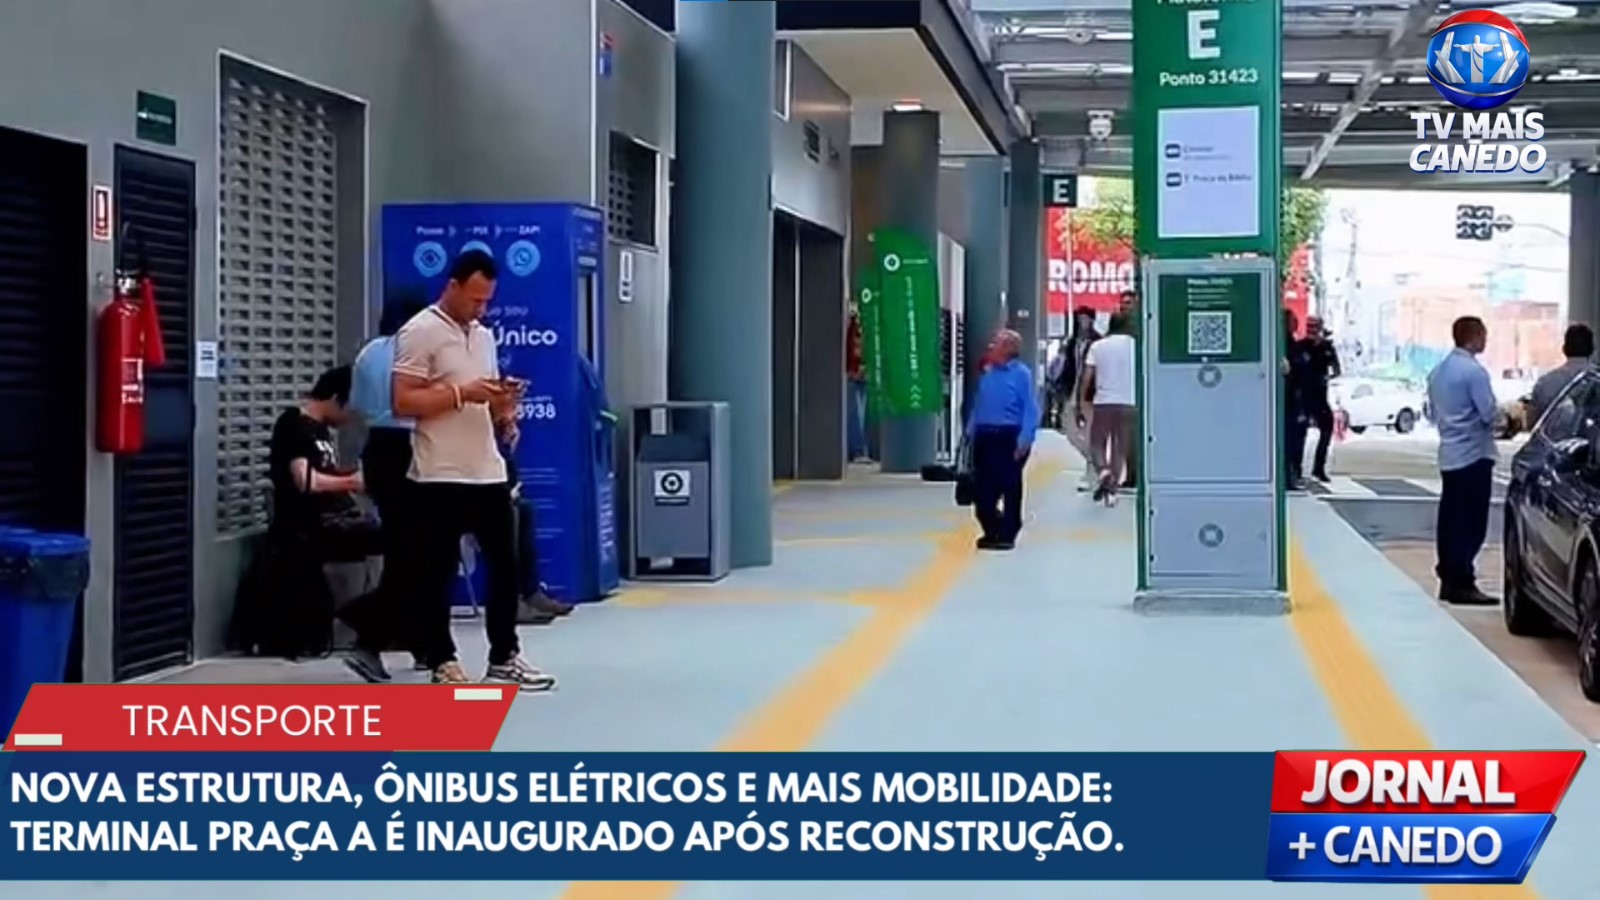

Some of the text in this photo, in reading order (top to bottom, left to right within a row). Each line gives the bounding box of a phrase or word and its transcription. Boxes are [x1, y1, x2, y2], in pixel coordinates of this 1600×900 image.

[1187, 10, 1220, 59] E
[1159, 68, 1259, 87] Ponto 31423
[1053, 178, 1070, 204] E
